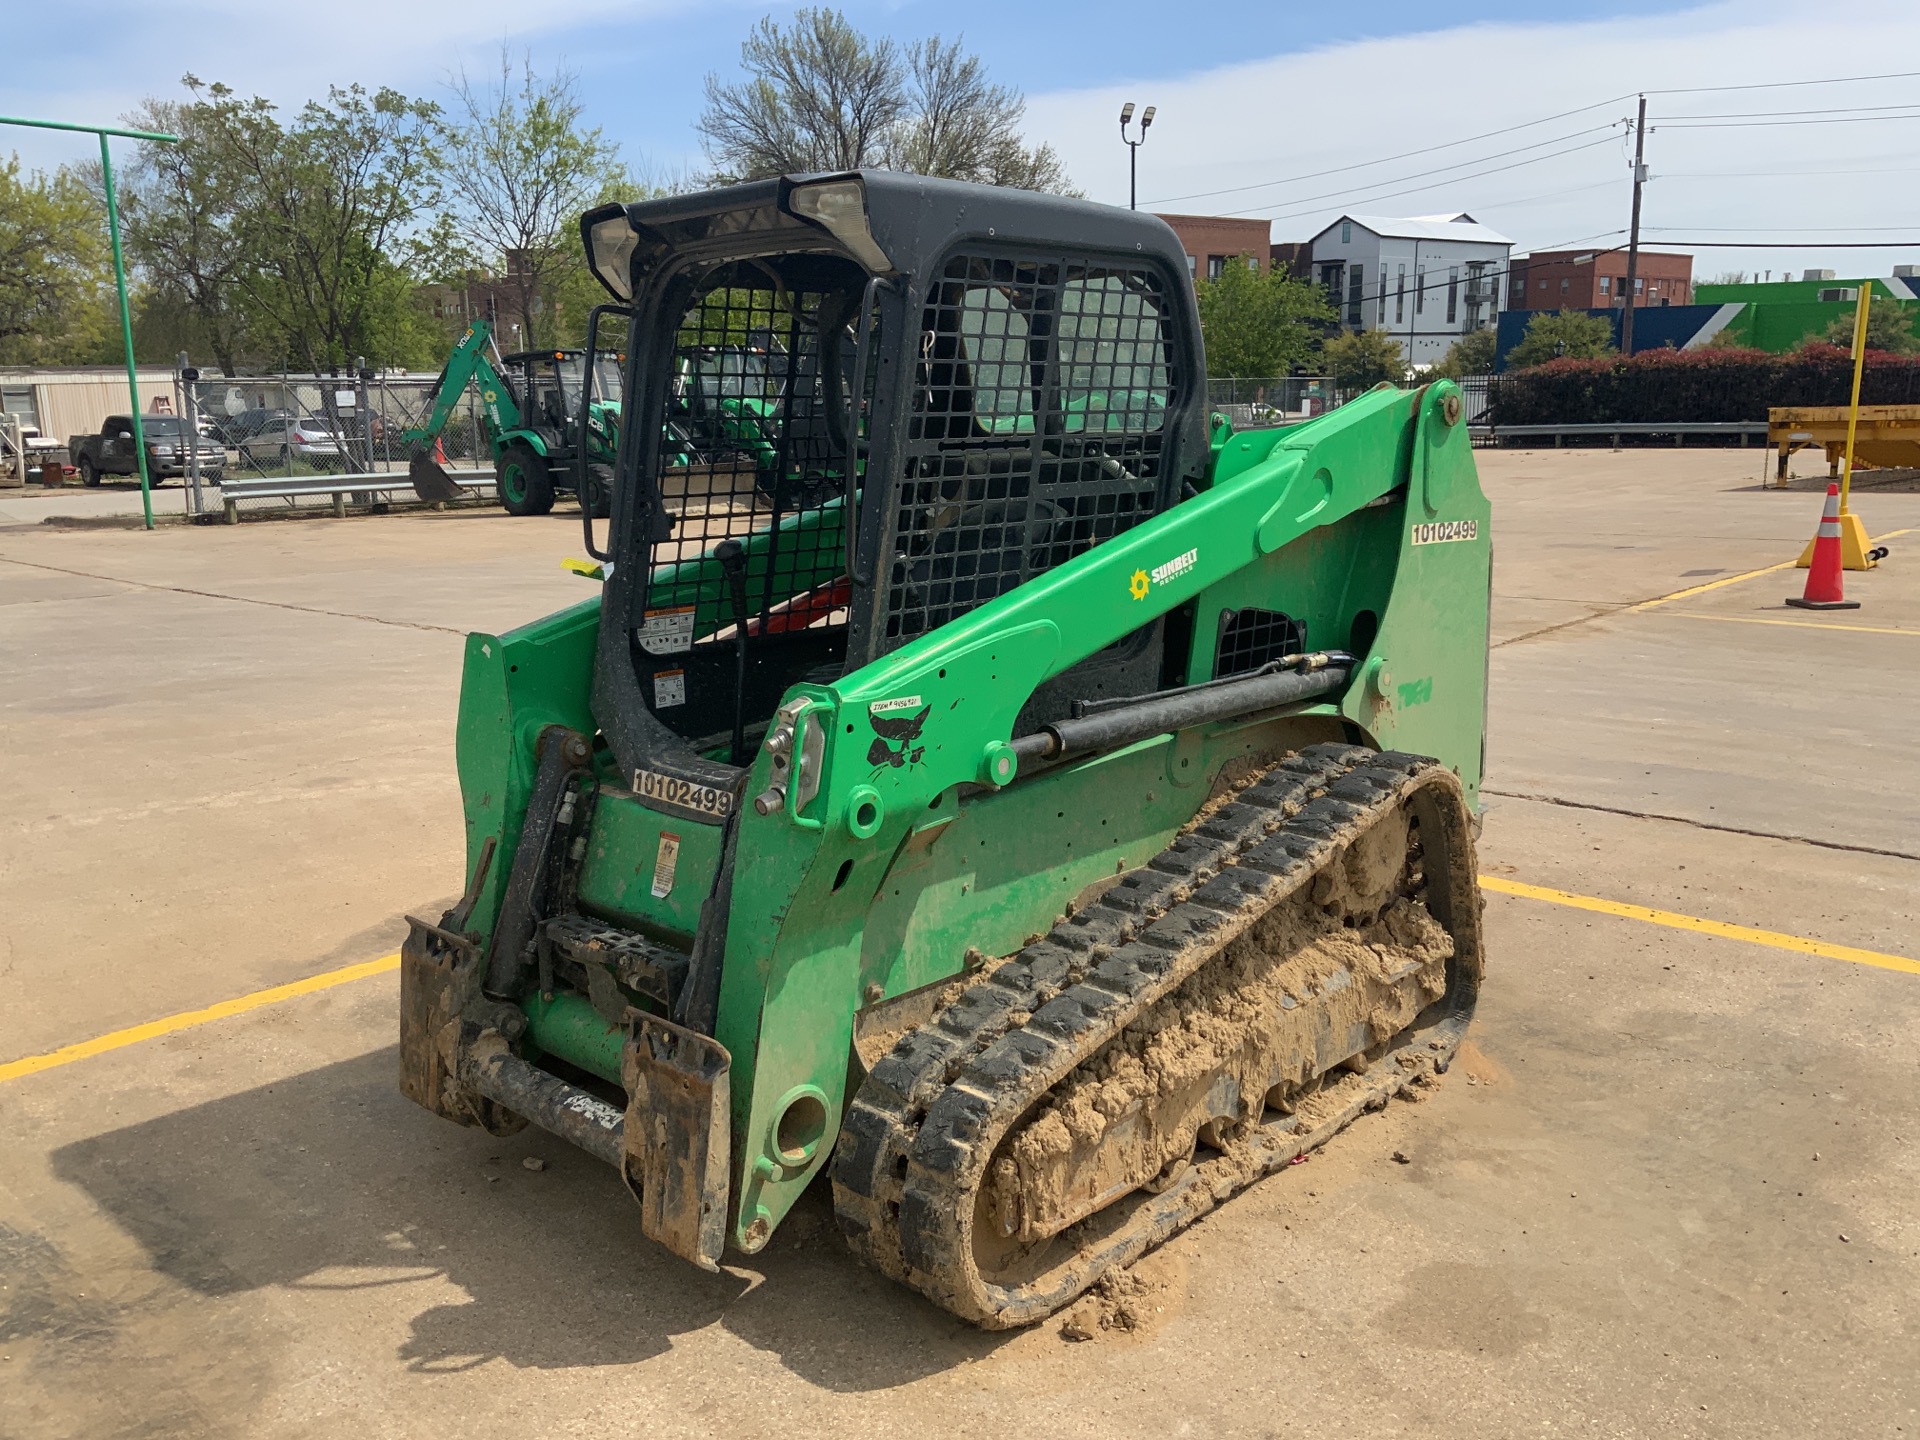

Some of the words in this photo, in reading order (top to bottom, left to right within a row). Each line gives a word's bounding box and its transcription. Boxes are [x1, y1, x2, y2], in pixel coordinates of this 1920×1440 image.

[1413, 520, 1477, 543] 10102499
[1151, 547, 1198, 584] SUNBELT
[1160, 565, 1193, 587] RENTALS
[636, 771, 731, 816] 10102499
